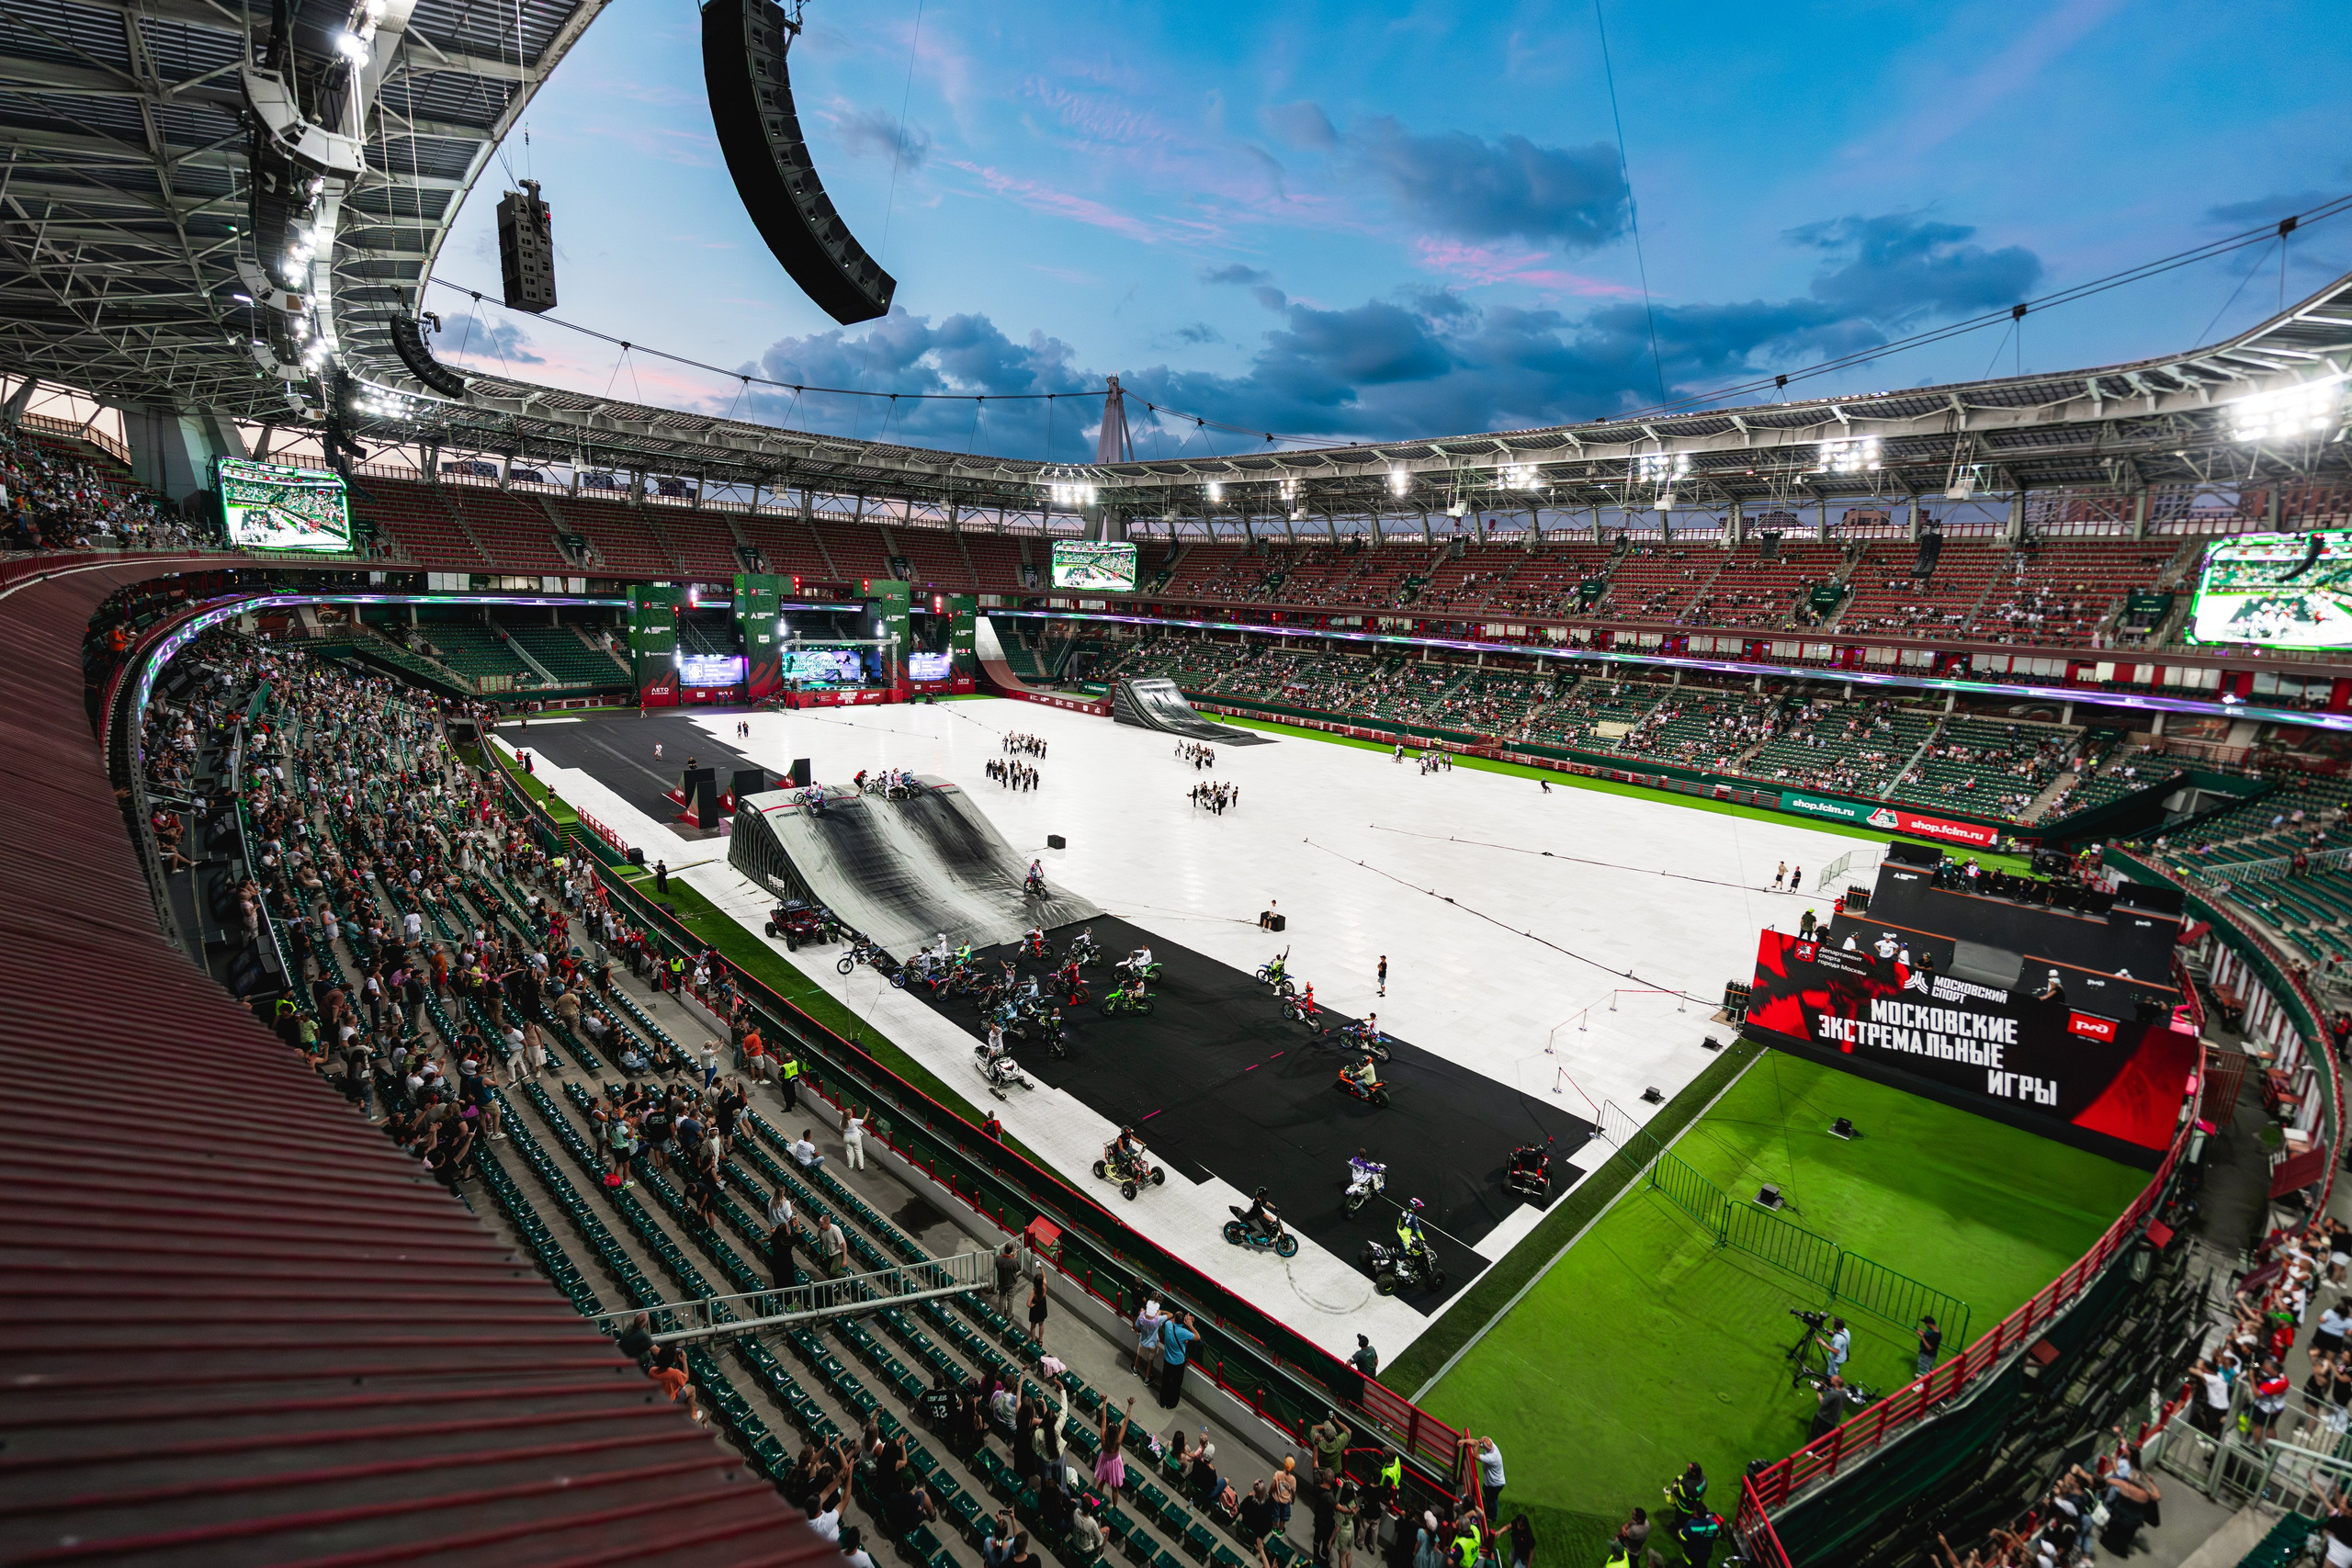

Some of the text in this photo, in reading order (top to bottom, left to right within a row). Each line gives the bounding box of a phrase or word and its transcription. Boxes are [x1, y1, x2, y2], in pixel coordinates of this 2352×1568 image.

[1792, 799, 1855, 817] shop.fclm.ru
[1911, 820, 1984, 840] shop.fclm.ru
[1818, 953, 1841, 963] спорта
[1819, 947, 1862, 962] Департамент
[1817, 959, 1867, 976] города Москвы
[1931, 986, 1967, 1004] СПОРТ
[1933, 976, 2008, 1004] МОСКОВСКИЙ
[1871, 998, 2018, 1045] МОСКОВСКИЕ
[1818, 1014, 2004, 1069] ЭКСТРЕМАЛЬНЫЕ
[1987, 1069, 2057, 1106] ИГРЫ
